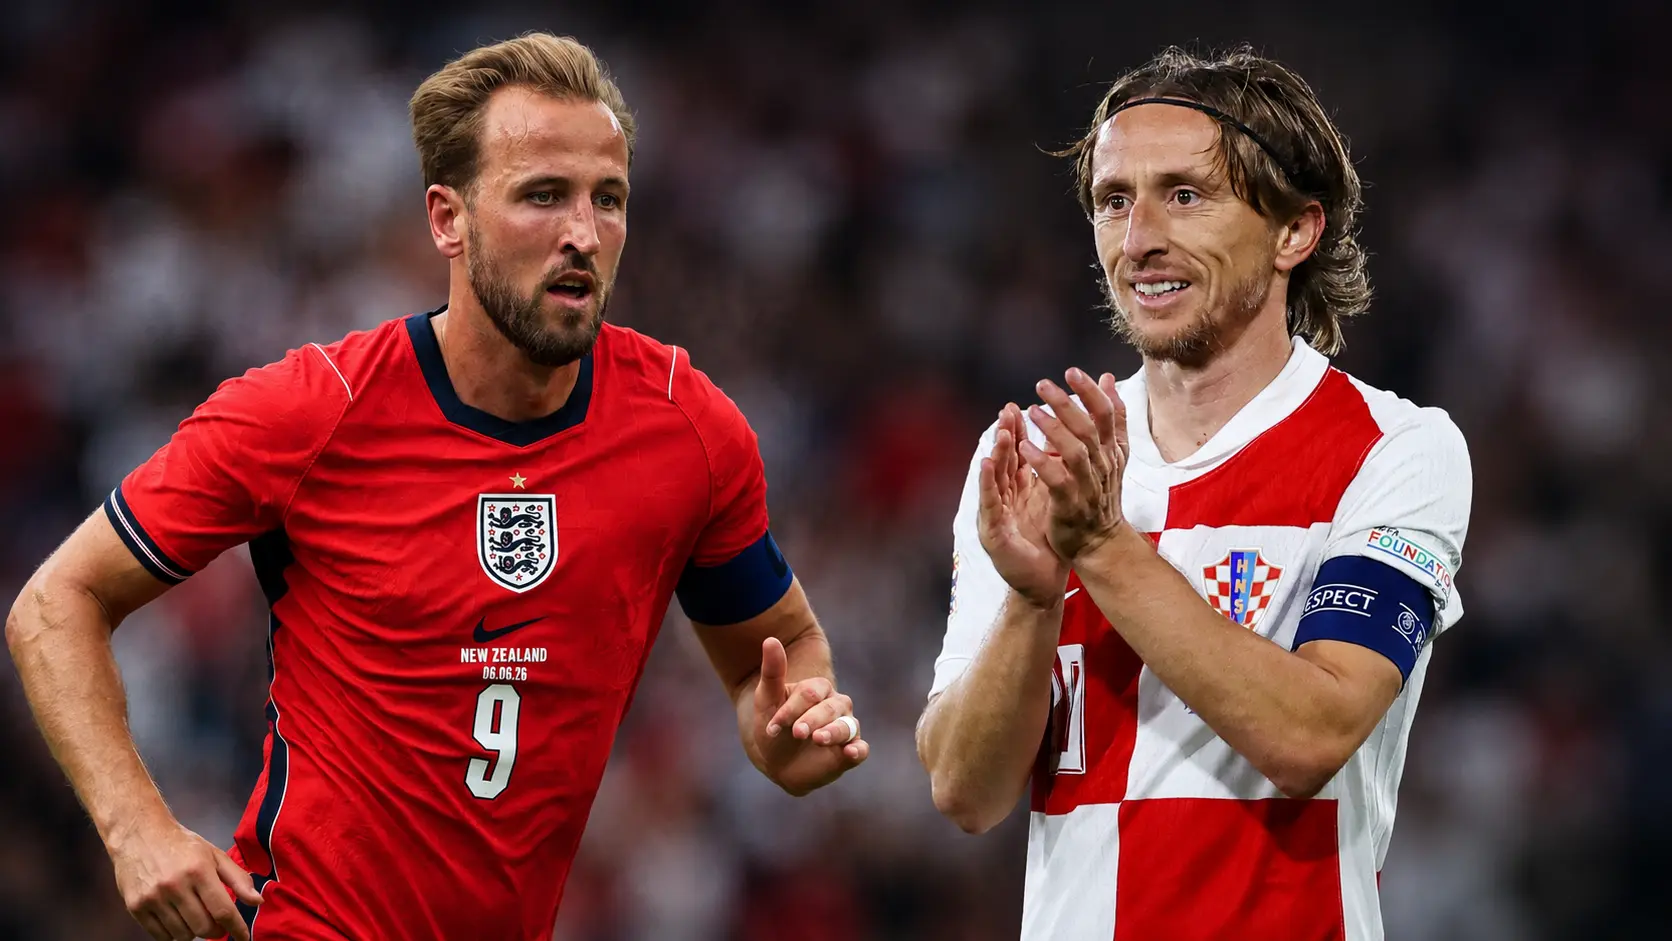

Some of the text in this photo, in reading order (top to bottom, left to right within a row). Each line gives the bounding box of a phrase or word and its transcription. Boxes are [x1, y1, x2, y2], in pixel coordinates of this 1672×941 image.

[1368, 530, 1451, 588] FOUNDATIO
[1234, 558, 1249, 614] HNS
[1305, 590, 1375, 613] ESPECT
[460, 647, 548, 663] NEW ZEALAND
[482, 665, 528, 681] 06.06.26
[464, 683, 522, 800] 9
